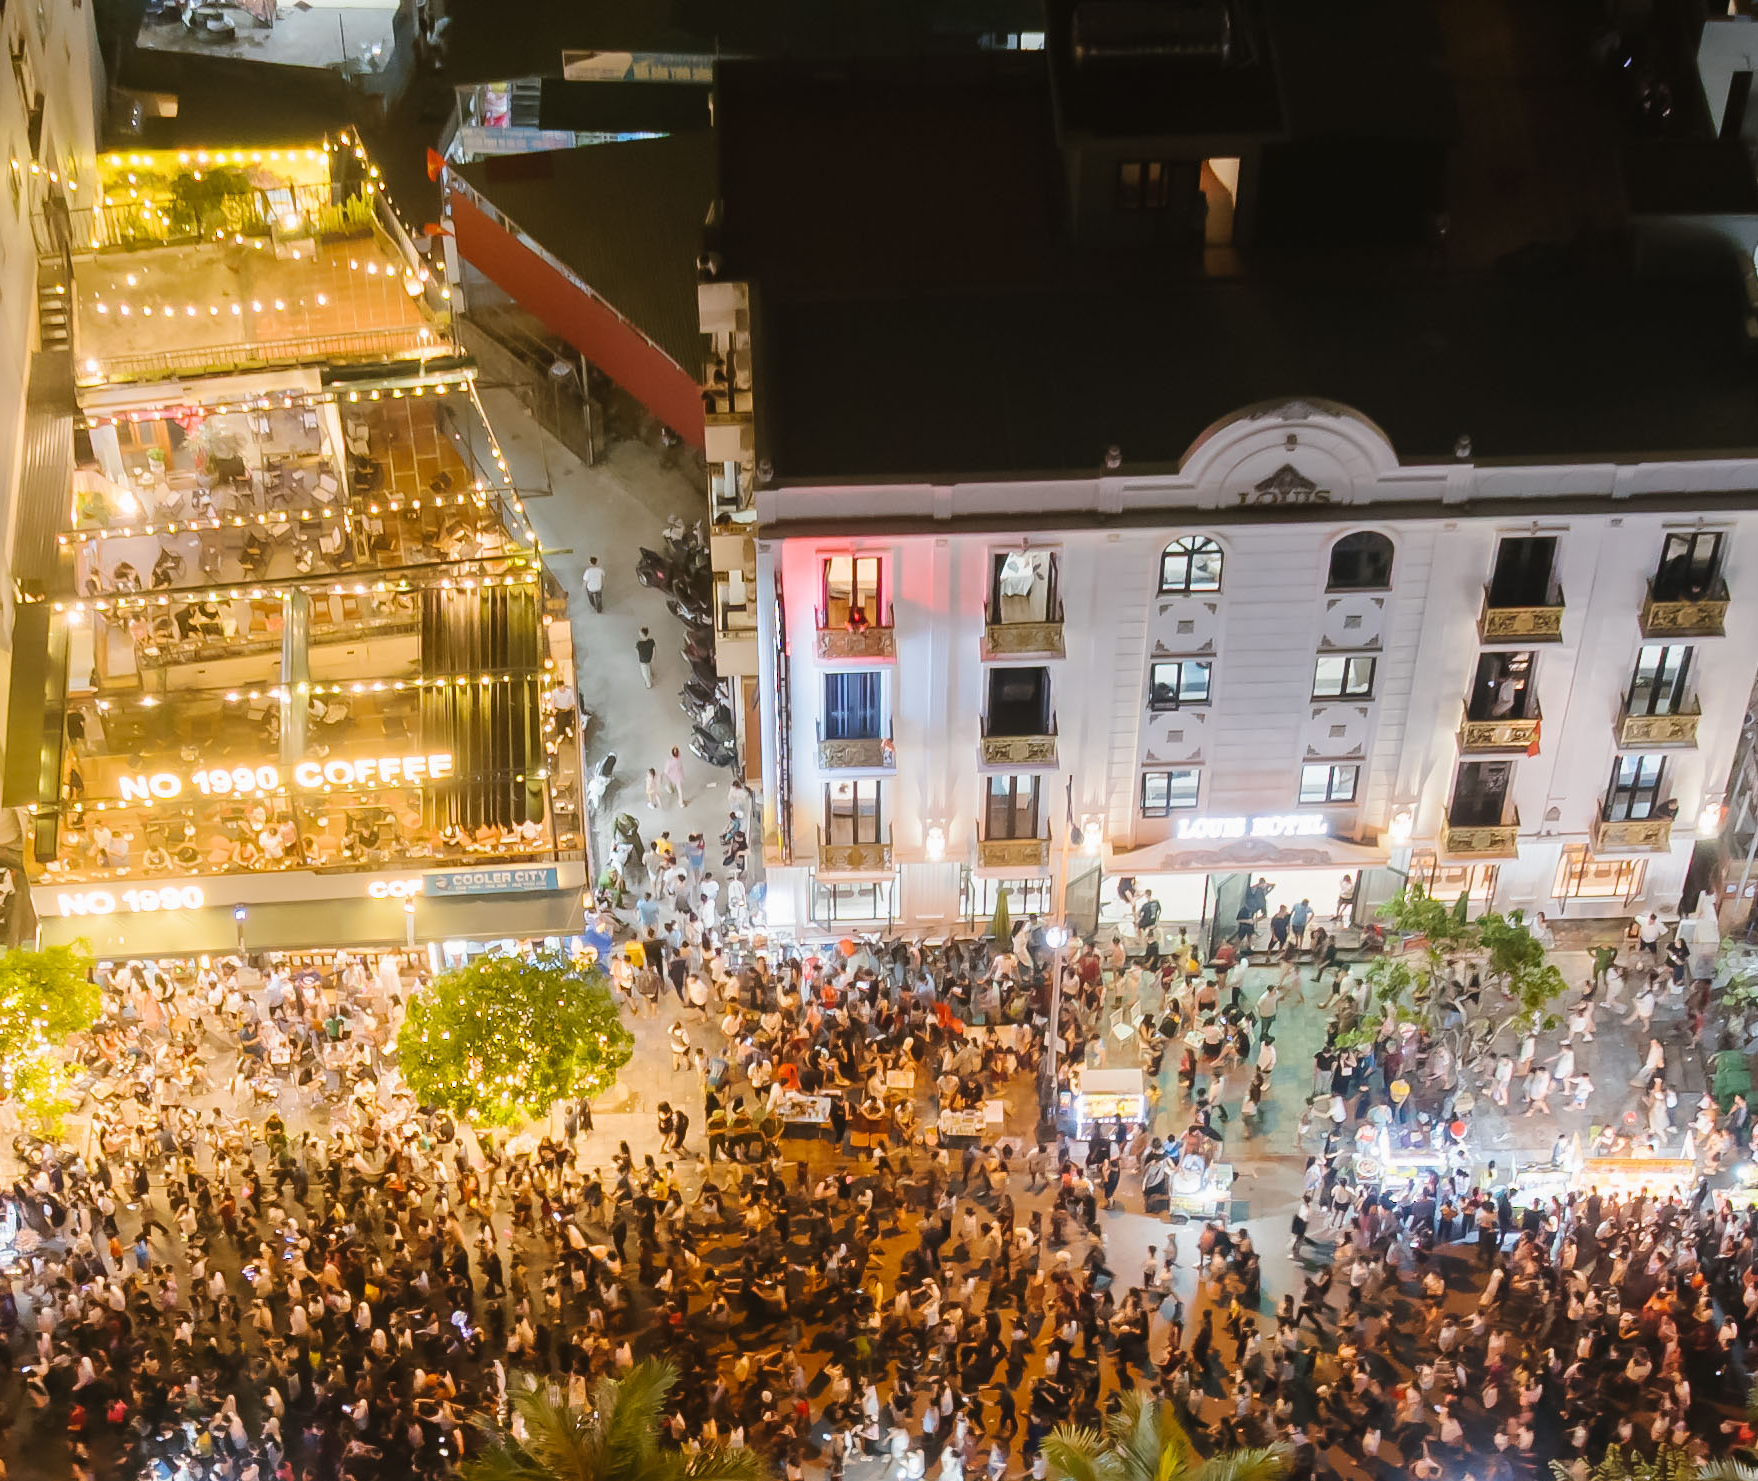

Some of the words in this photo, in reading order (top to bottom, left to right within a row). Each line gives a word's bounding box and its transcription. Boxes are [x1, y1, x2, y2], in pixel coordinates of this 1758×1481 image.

[119, 774, 181, 801] NO
[191, 766, 278, 794] 1990
[295, 754, 453, 789] COFFEE
[1249, 814, 1329, 837] HOTEL
[452, 871, 511, 886] COOLER
[514, 869, 548, 882] CITY
[56, 891, 115, 917] NO
[121, 885, 205, 914] 1990
